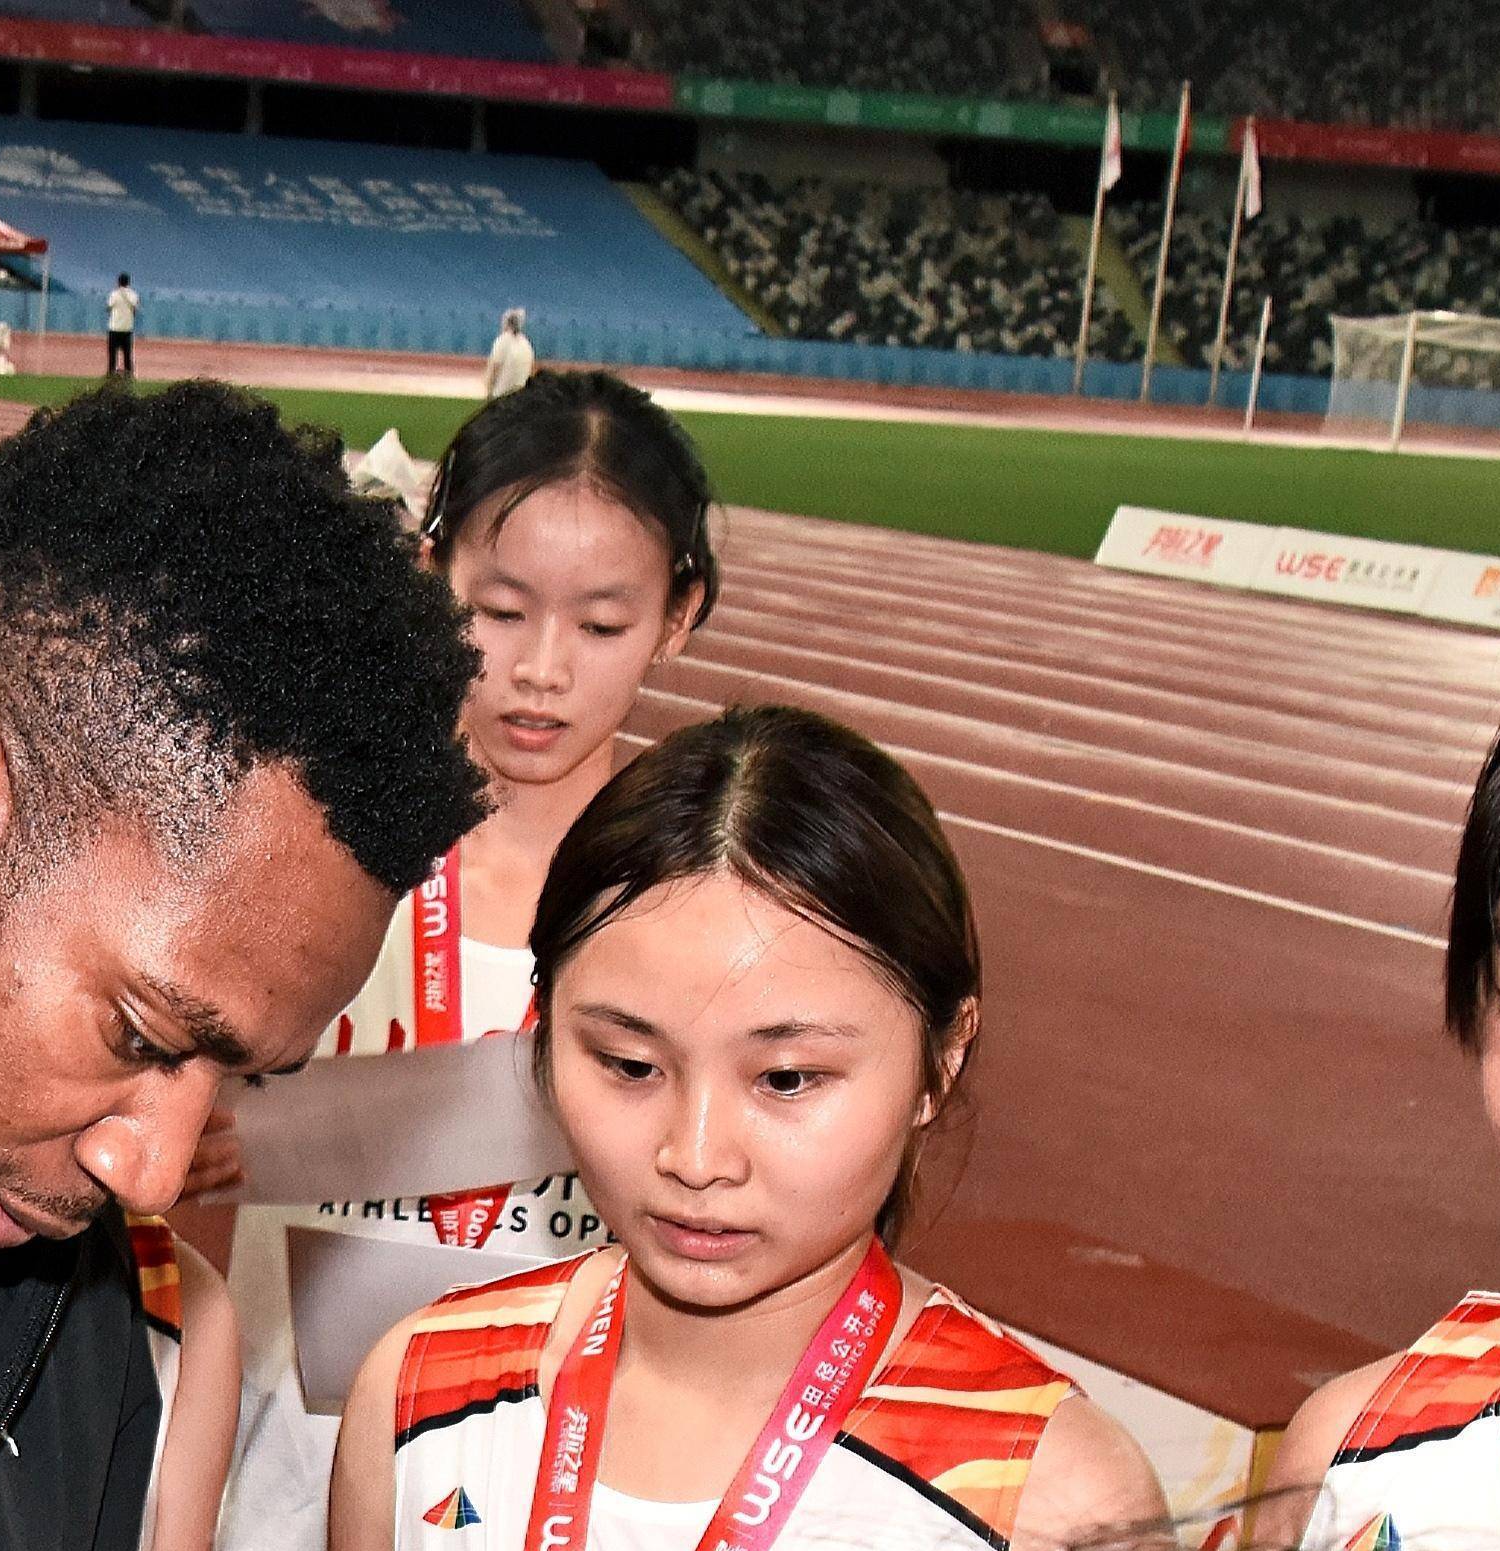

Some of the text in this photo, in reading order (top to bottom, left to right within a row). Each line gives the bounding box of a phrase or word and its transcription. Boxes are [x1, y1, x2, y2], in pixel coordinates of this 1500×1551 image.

[732, 1402, 825, 1527] WSE
[802, 1288, 878, 1407] 田径公开赛
[823, 1300, 887, 1410] ATHLETICS OPEN
